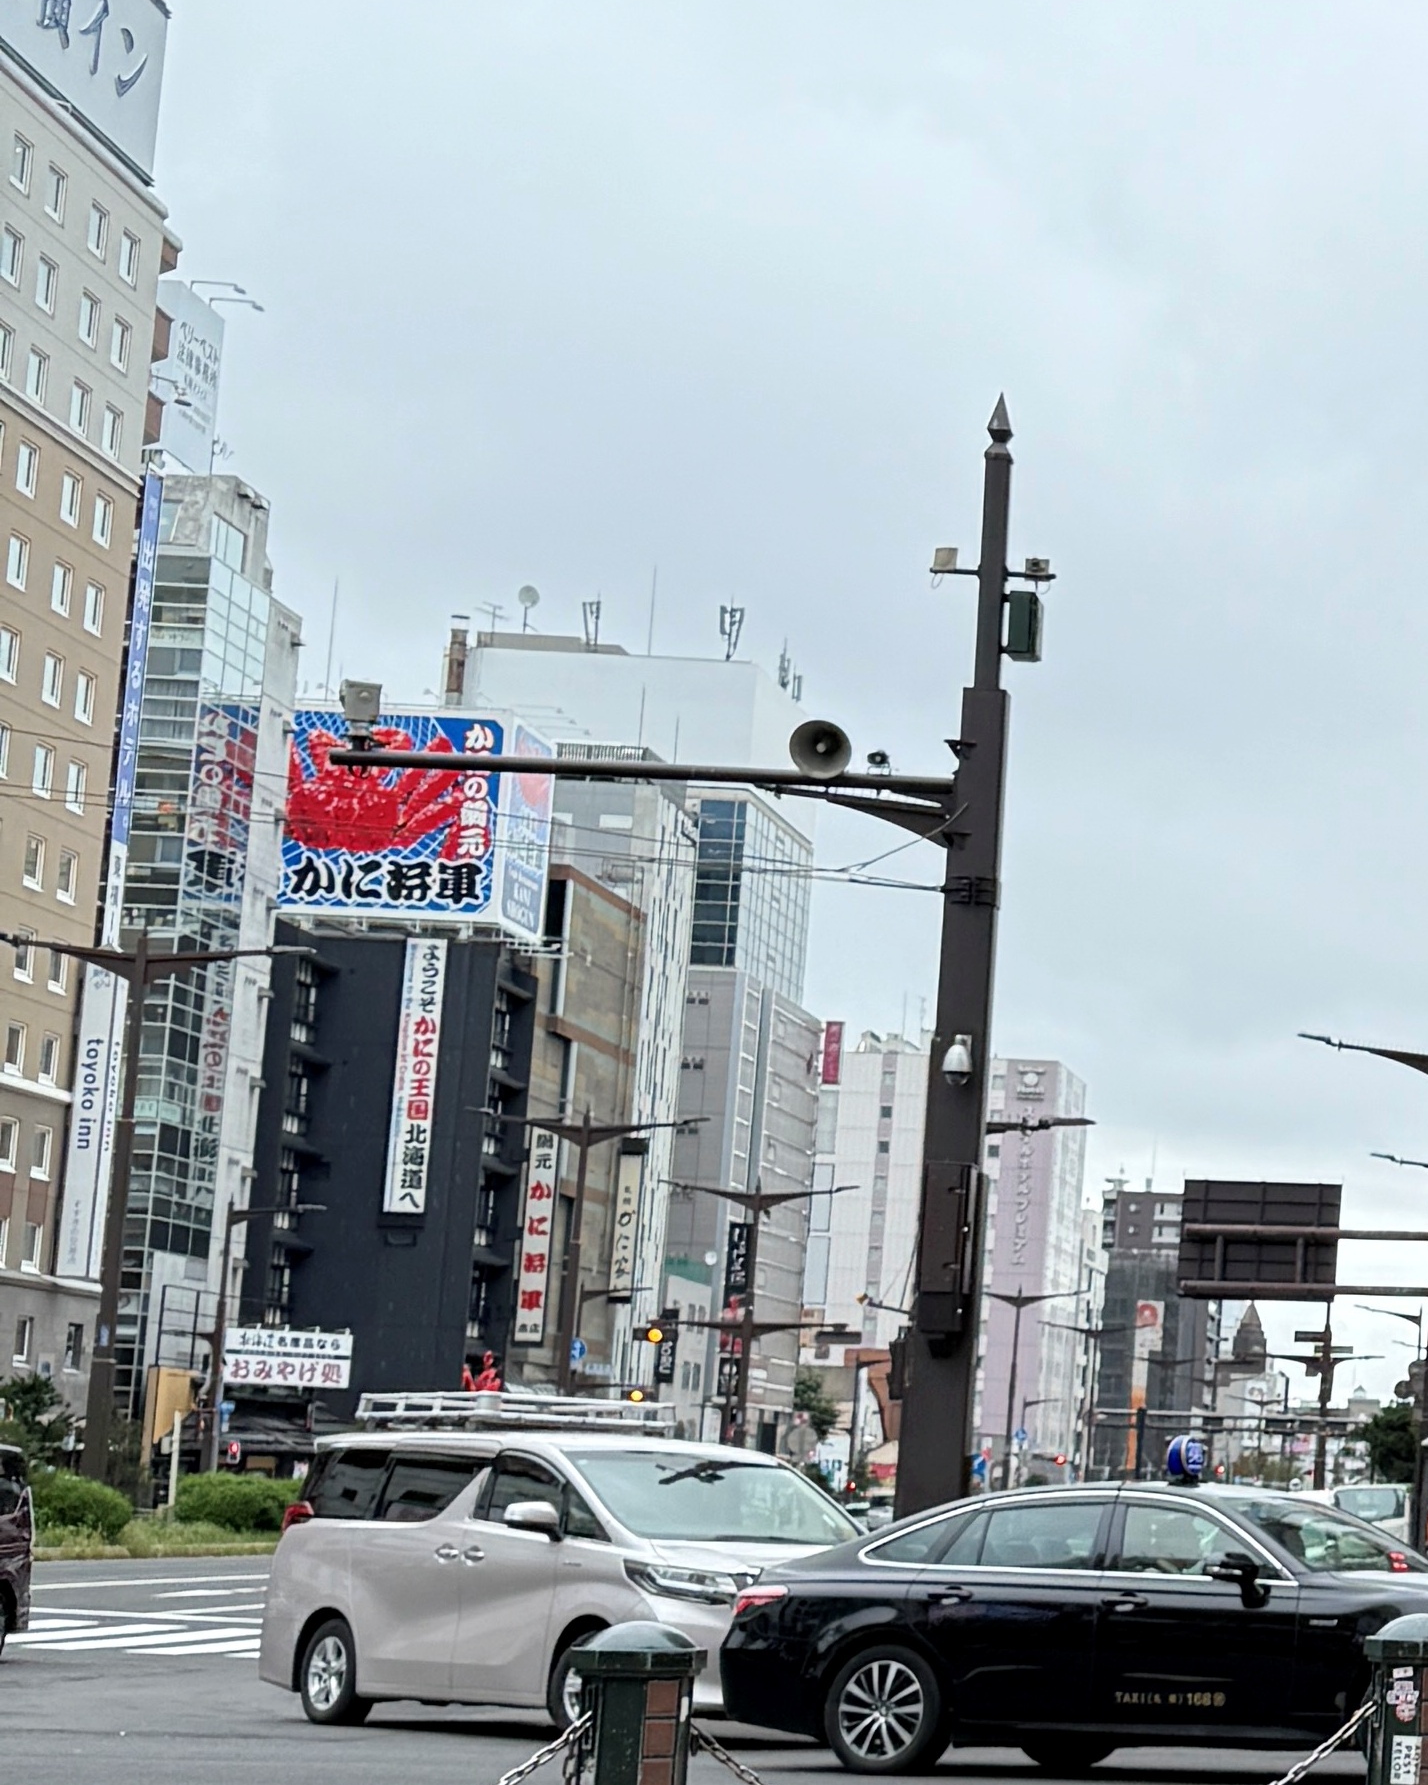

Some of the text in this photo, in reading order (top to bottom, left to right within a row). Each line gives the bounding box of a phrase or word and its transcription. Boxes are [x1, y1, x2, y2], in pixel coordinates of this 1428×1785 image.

[457, 723, 493, 857] かの網元
[290, 855, 483, 906] かに将軍
[76, 1038, 104, 1151] toyoko inn
[520, 1179, 552, 1312] かに将軍
[230, 1358, 342, 1384] おみやげ処
